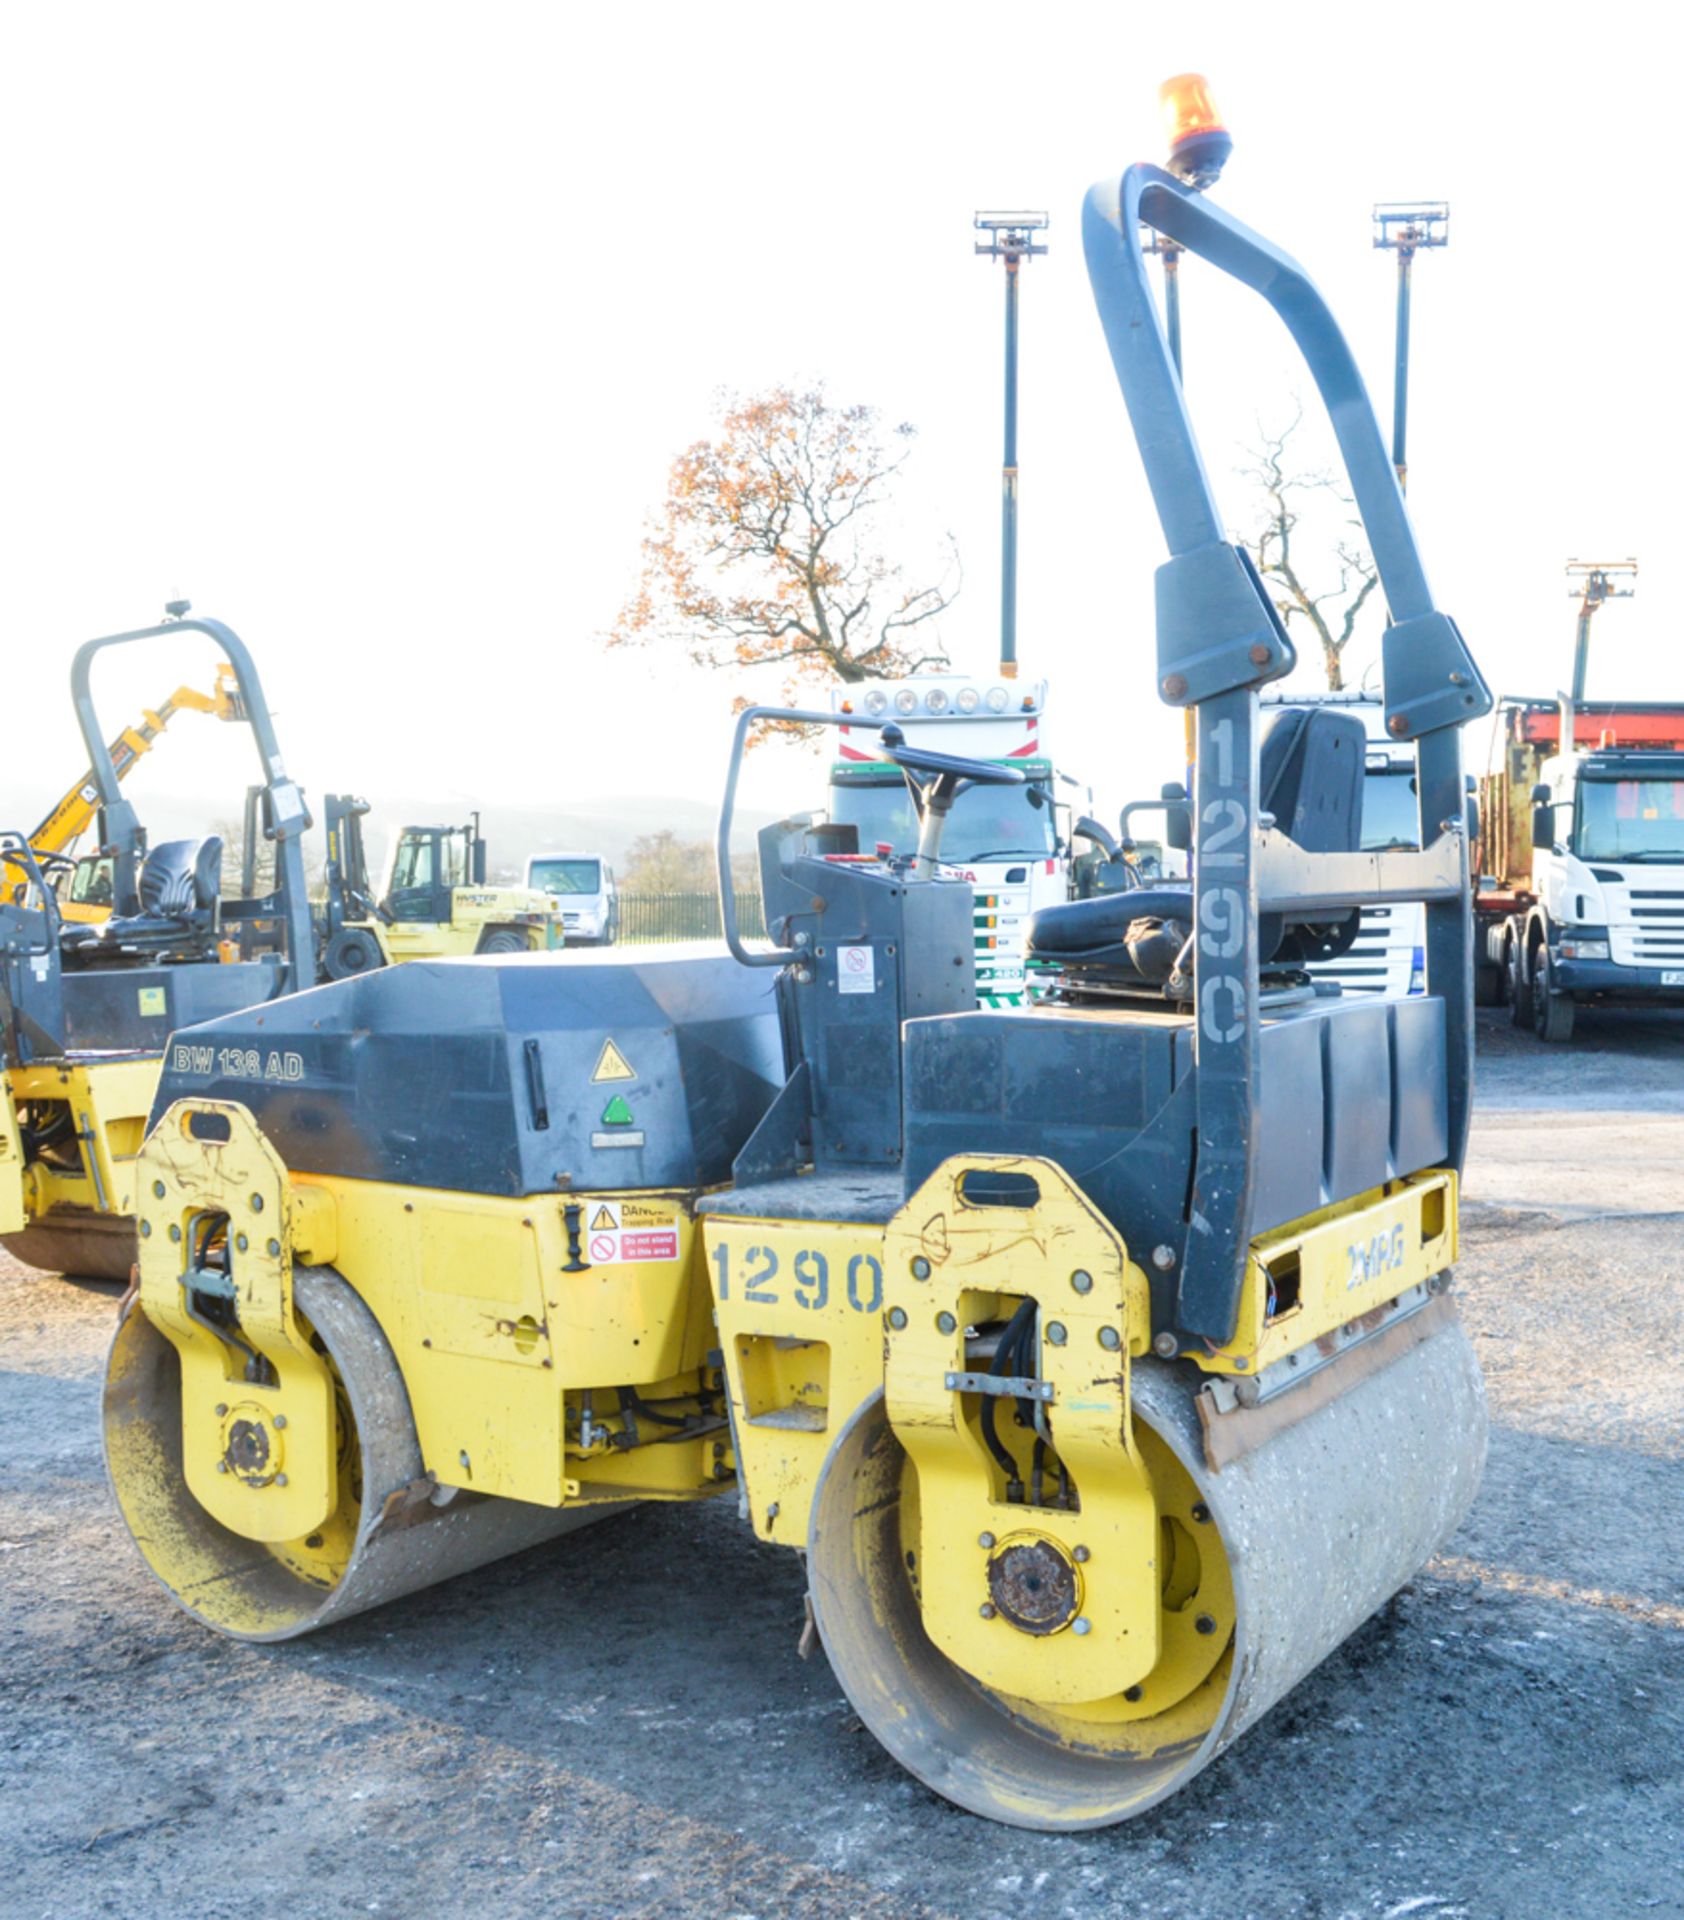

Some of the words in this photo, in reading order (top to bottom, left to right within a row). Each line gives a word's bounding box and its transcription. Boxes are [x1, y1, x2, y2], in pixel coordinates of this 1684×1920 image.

[1200, 718, 1247, 1043] 1290
[172, 1044, 215, 1075] BW
[218, 1047, 261, 1079] 138
[264, 1051, 305, 1081] AD
[621, 1204, 665, 1216] DAN
[637, 1236, 650, 1244] not
[652, 1235, 673, 1243] stand
[637, 1247, 652, 1256] this
[654, 1247, 671, 1256] area
[713, 1243, 883, 1314] 1290
